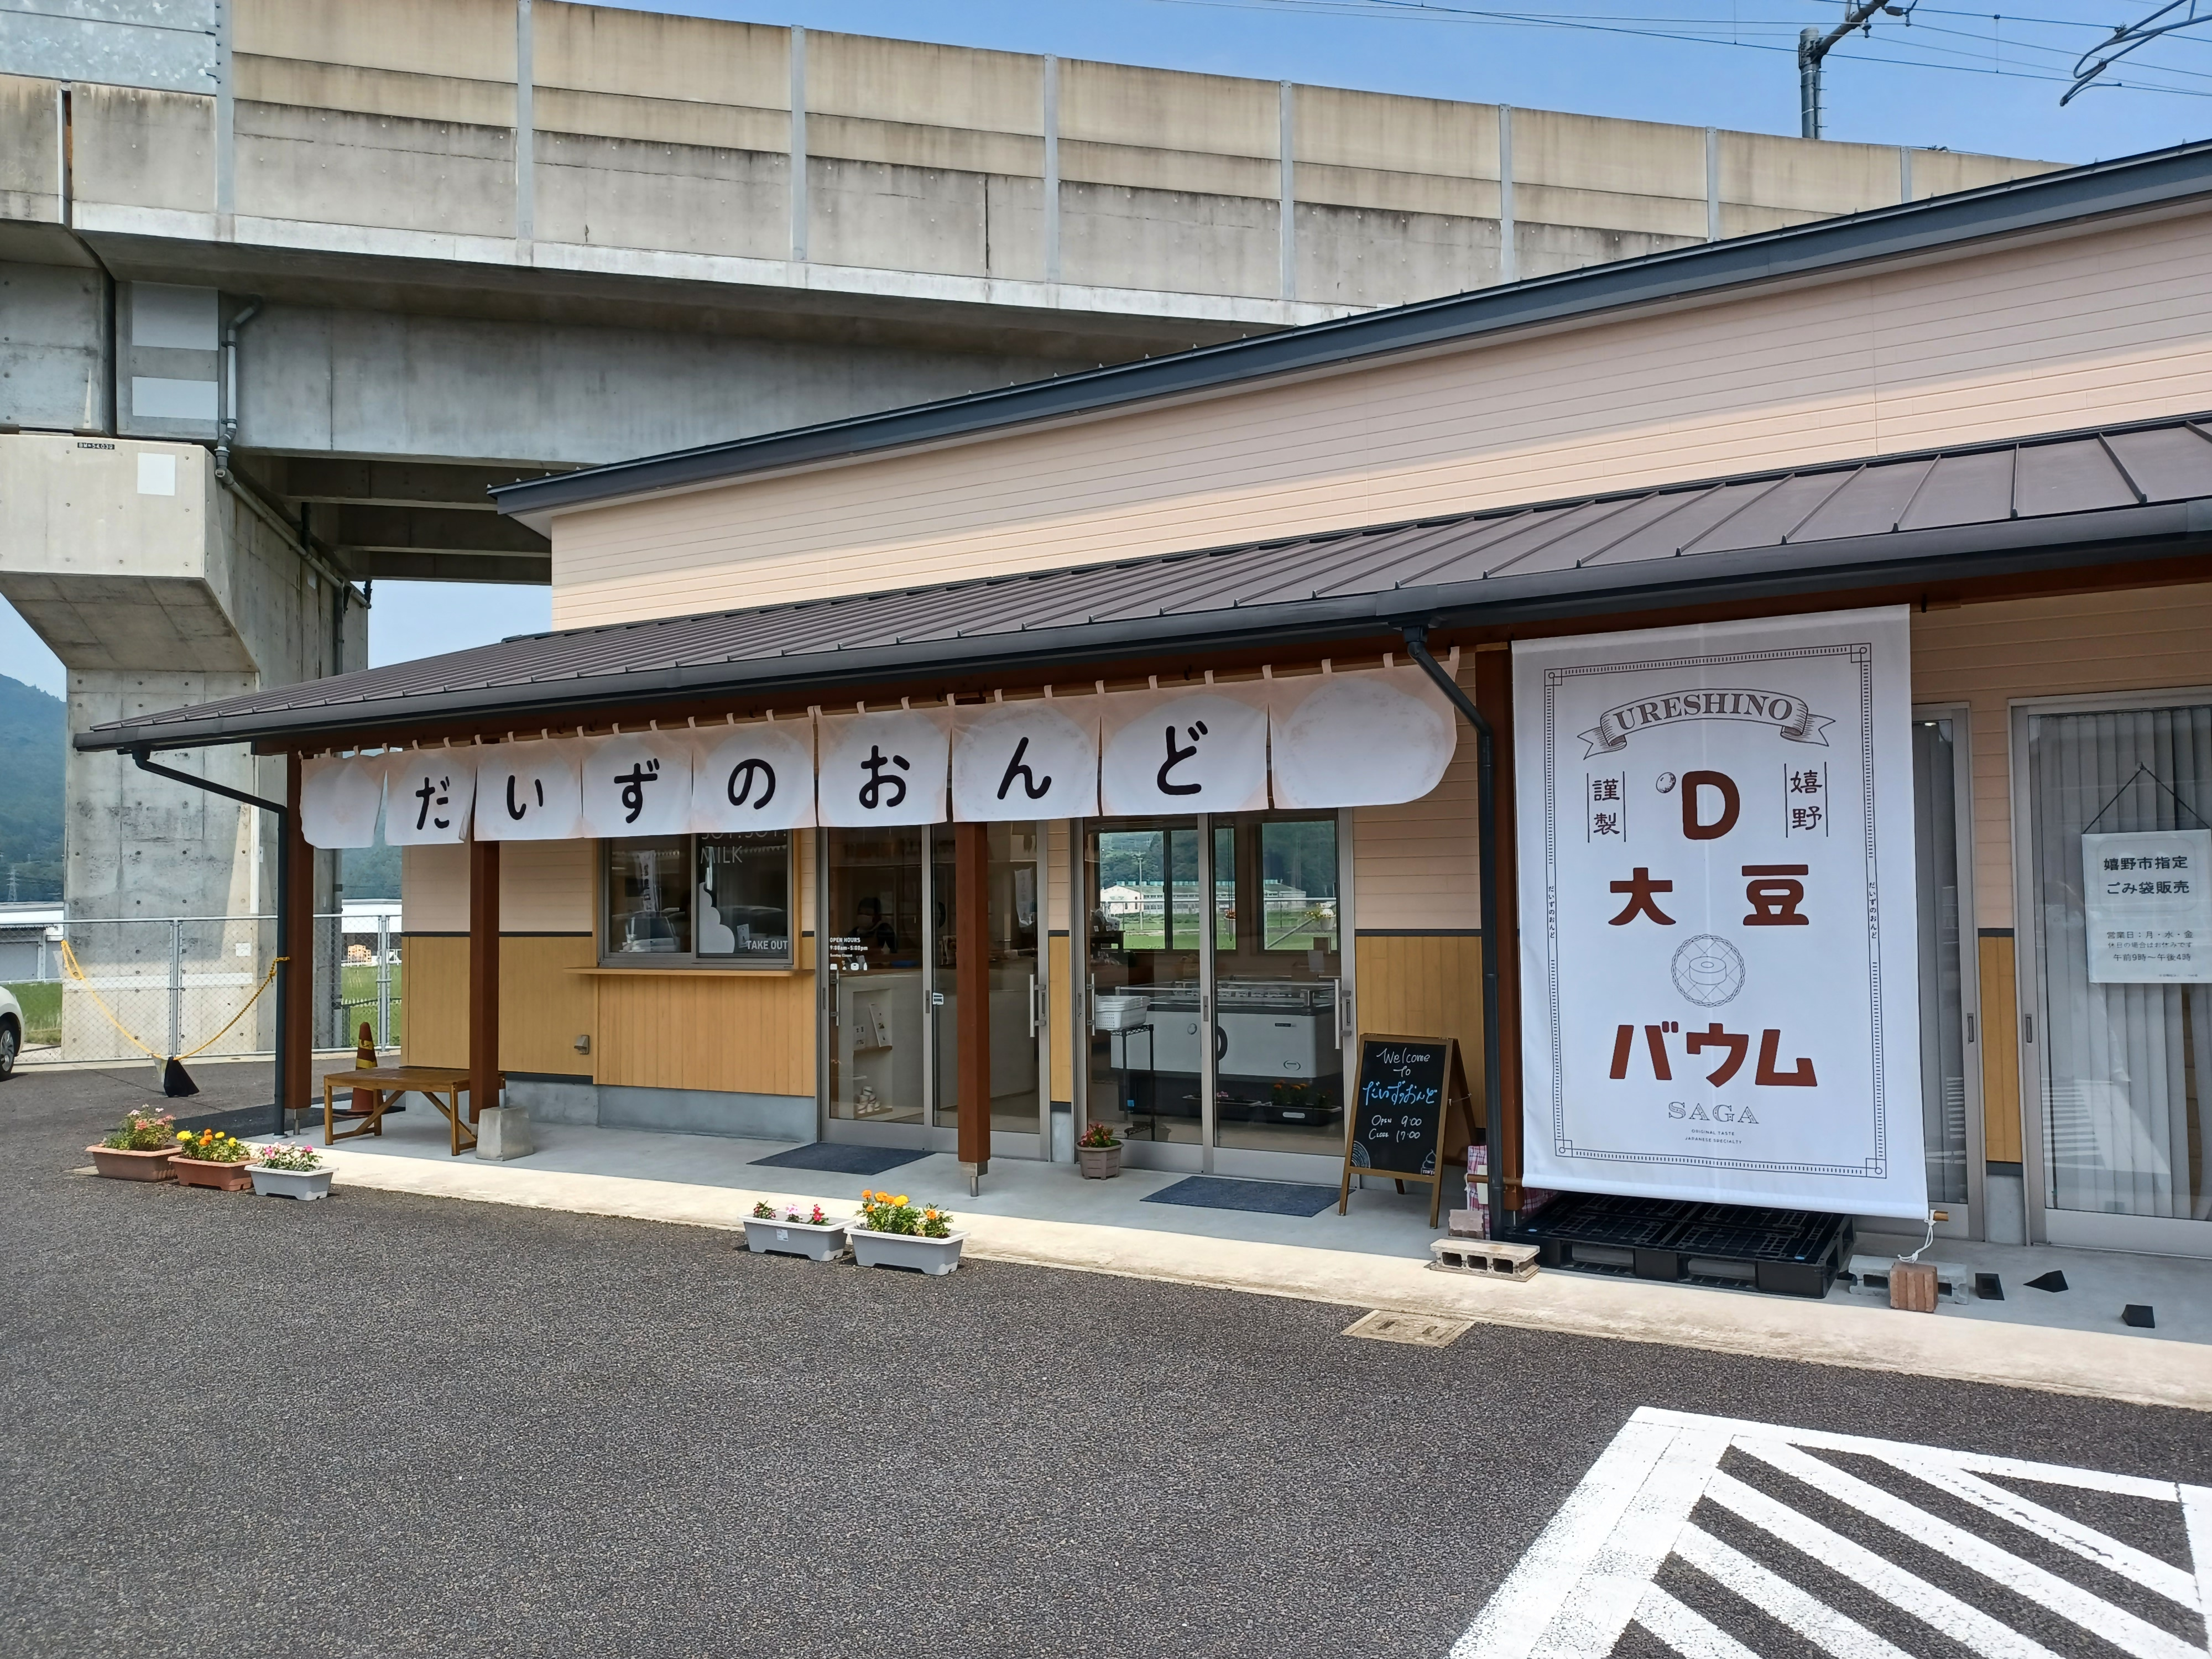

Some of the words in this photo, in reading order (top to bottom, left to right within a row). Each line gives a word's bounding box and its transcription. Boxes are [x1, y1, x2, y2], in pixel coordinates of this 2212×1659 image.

[1613, 693, 1792, 730] URESHINO
[415, 721, 1208, 830] だいずのおんど
[1592, 779, 1620, 835] 謹製
[1682, 770, 1740, 840] D
[1790, 770, 1823, 830] 嬉野
[701, 846, 743, 864] MILK
[2104, 855, 2188, 870] 嬉野市指定
[2107, 880, 2190, 894] ごみ袋販売
[745, 941, 769, 950] TAKE
[771, 941, 788, 950] OUT
[1376, 1047, 1431, 1063] Welcome
[1609, 1021, 1818, 1088] バウム
[1668, 1102, 1760, 1124] SAGA
